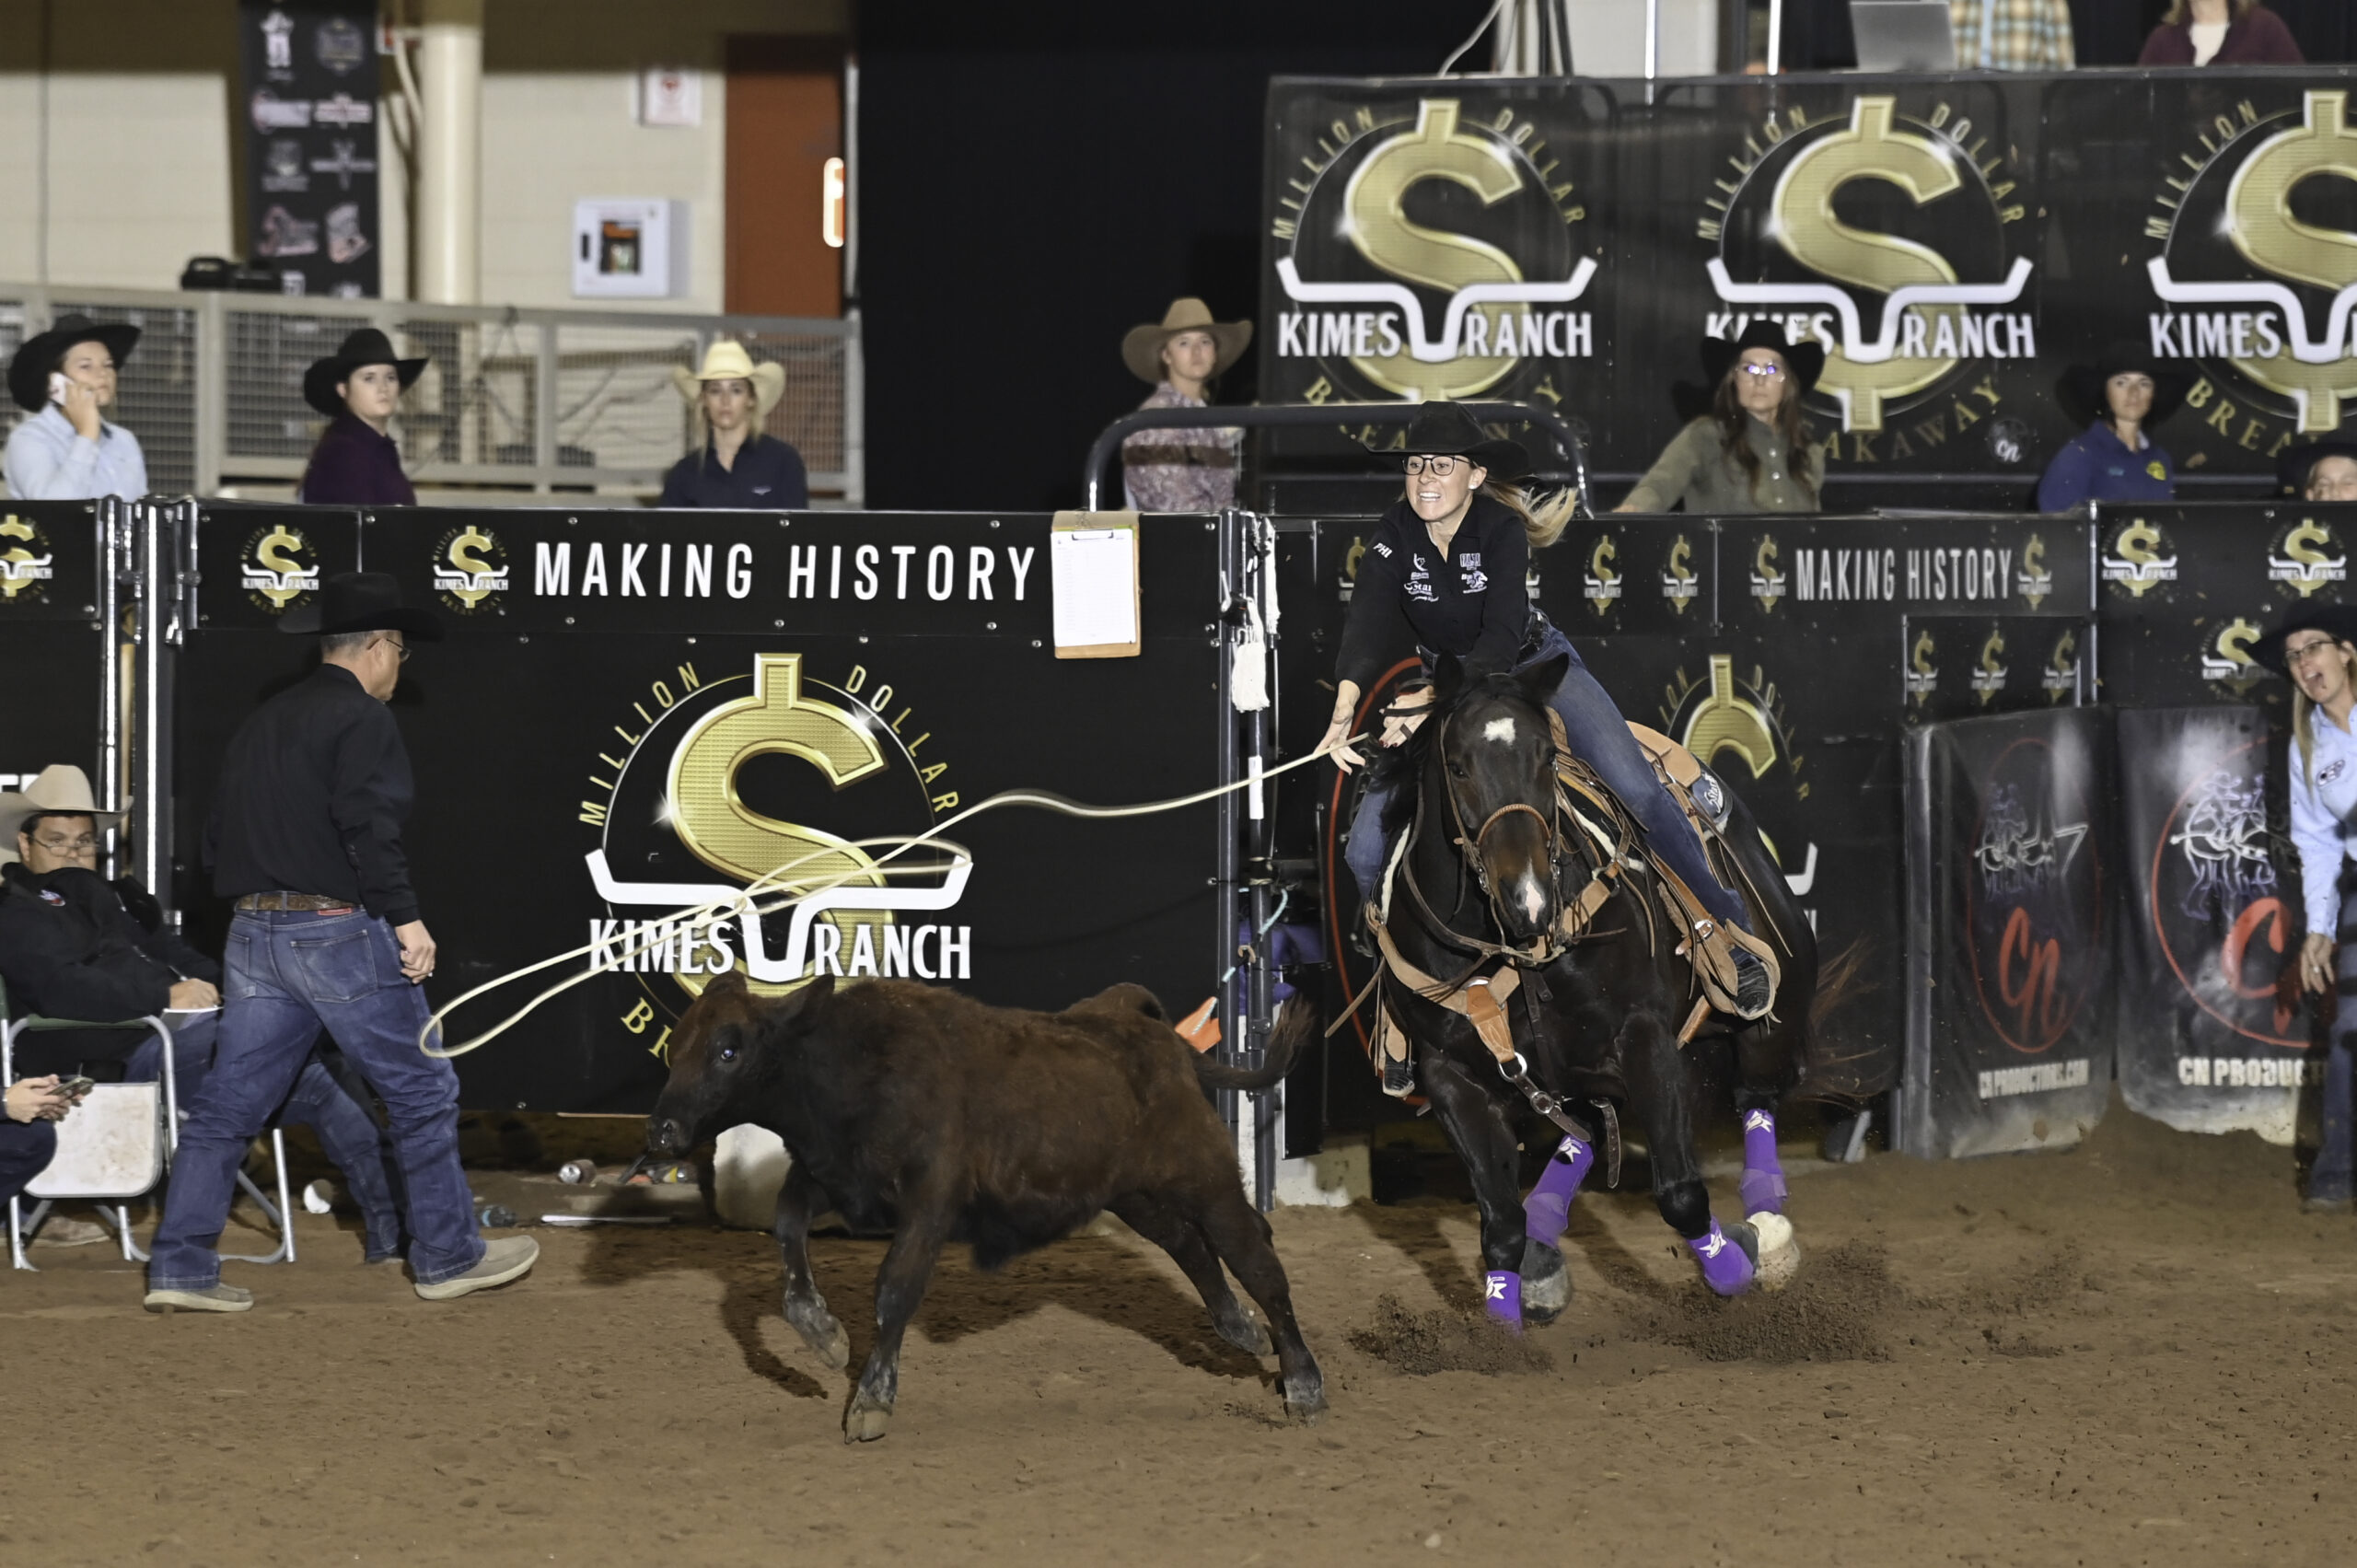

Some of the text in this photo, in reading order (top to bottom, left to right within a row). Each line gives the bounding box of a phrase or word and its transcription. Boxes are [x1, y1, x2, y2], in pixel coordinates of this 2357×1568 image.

[1272, 106, 1585, 239] MILLION DOLLAR
[1698, 101, 2026, 240] MILLION DOLLAR
[2144, 99, 2258, 240] MILLION
[1277, 311, 1593, 357] KIMES RANCH
[1902, 313, 2037, 358] RANCH
[2149, 311, 2282, 358] KIMES
[535, 541, 753, 599] MAKING
[788, 544, 1035, 601] HISTORY
[1795, 548, 2013, 600] MAKING HISTORY
[579, 662, 959, 827] MILLION DOLLAR
[587, 919, 972, 980] KIMES RANCH
[2177, 1057, 2211, 1086] CN
